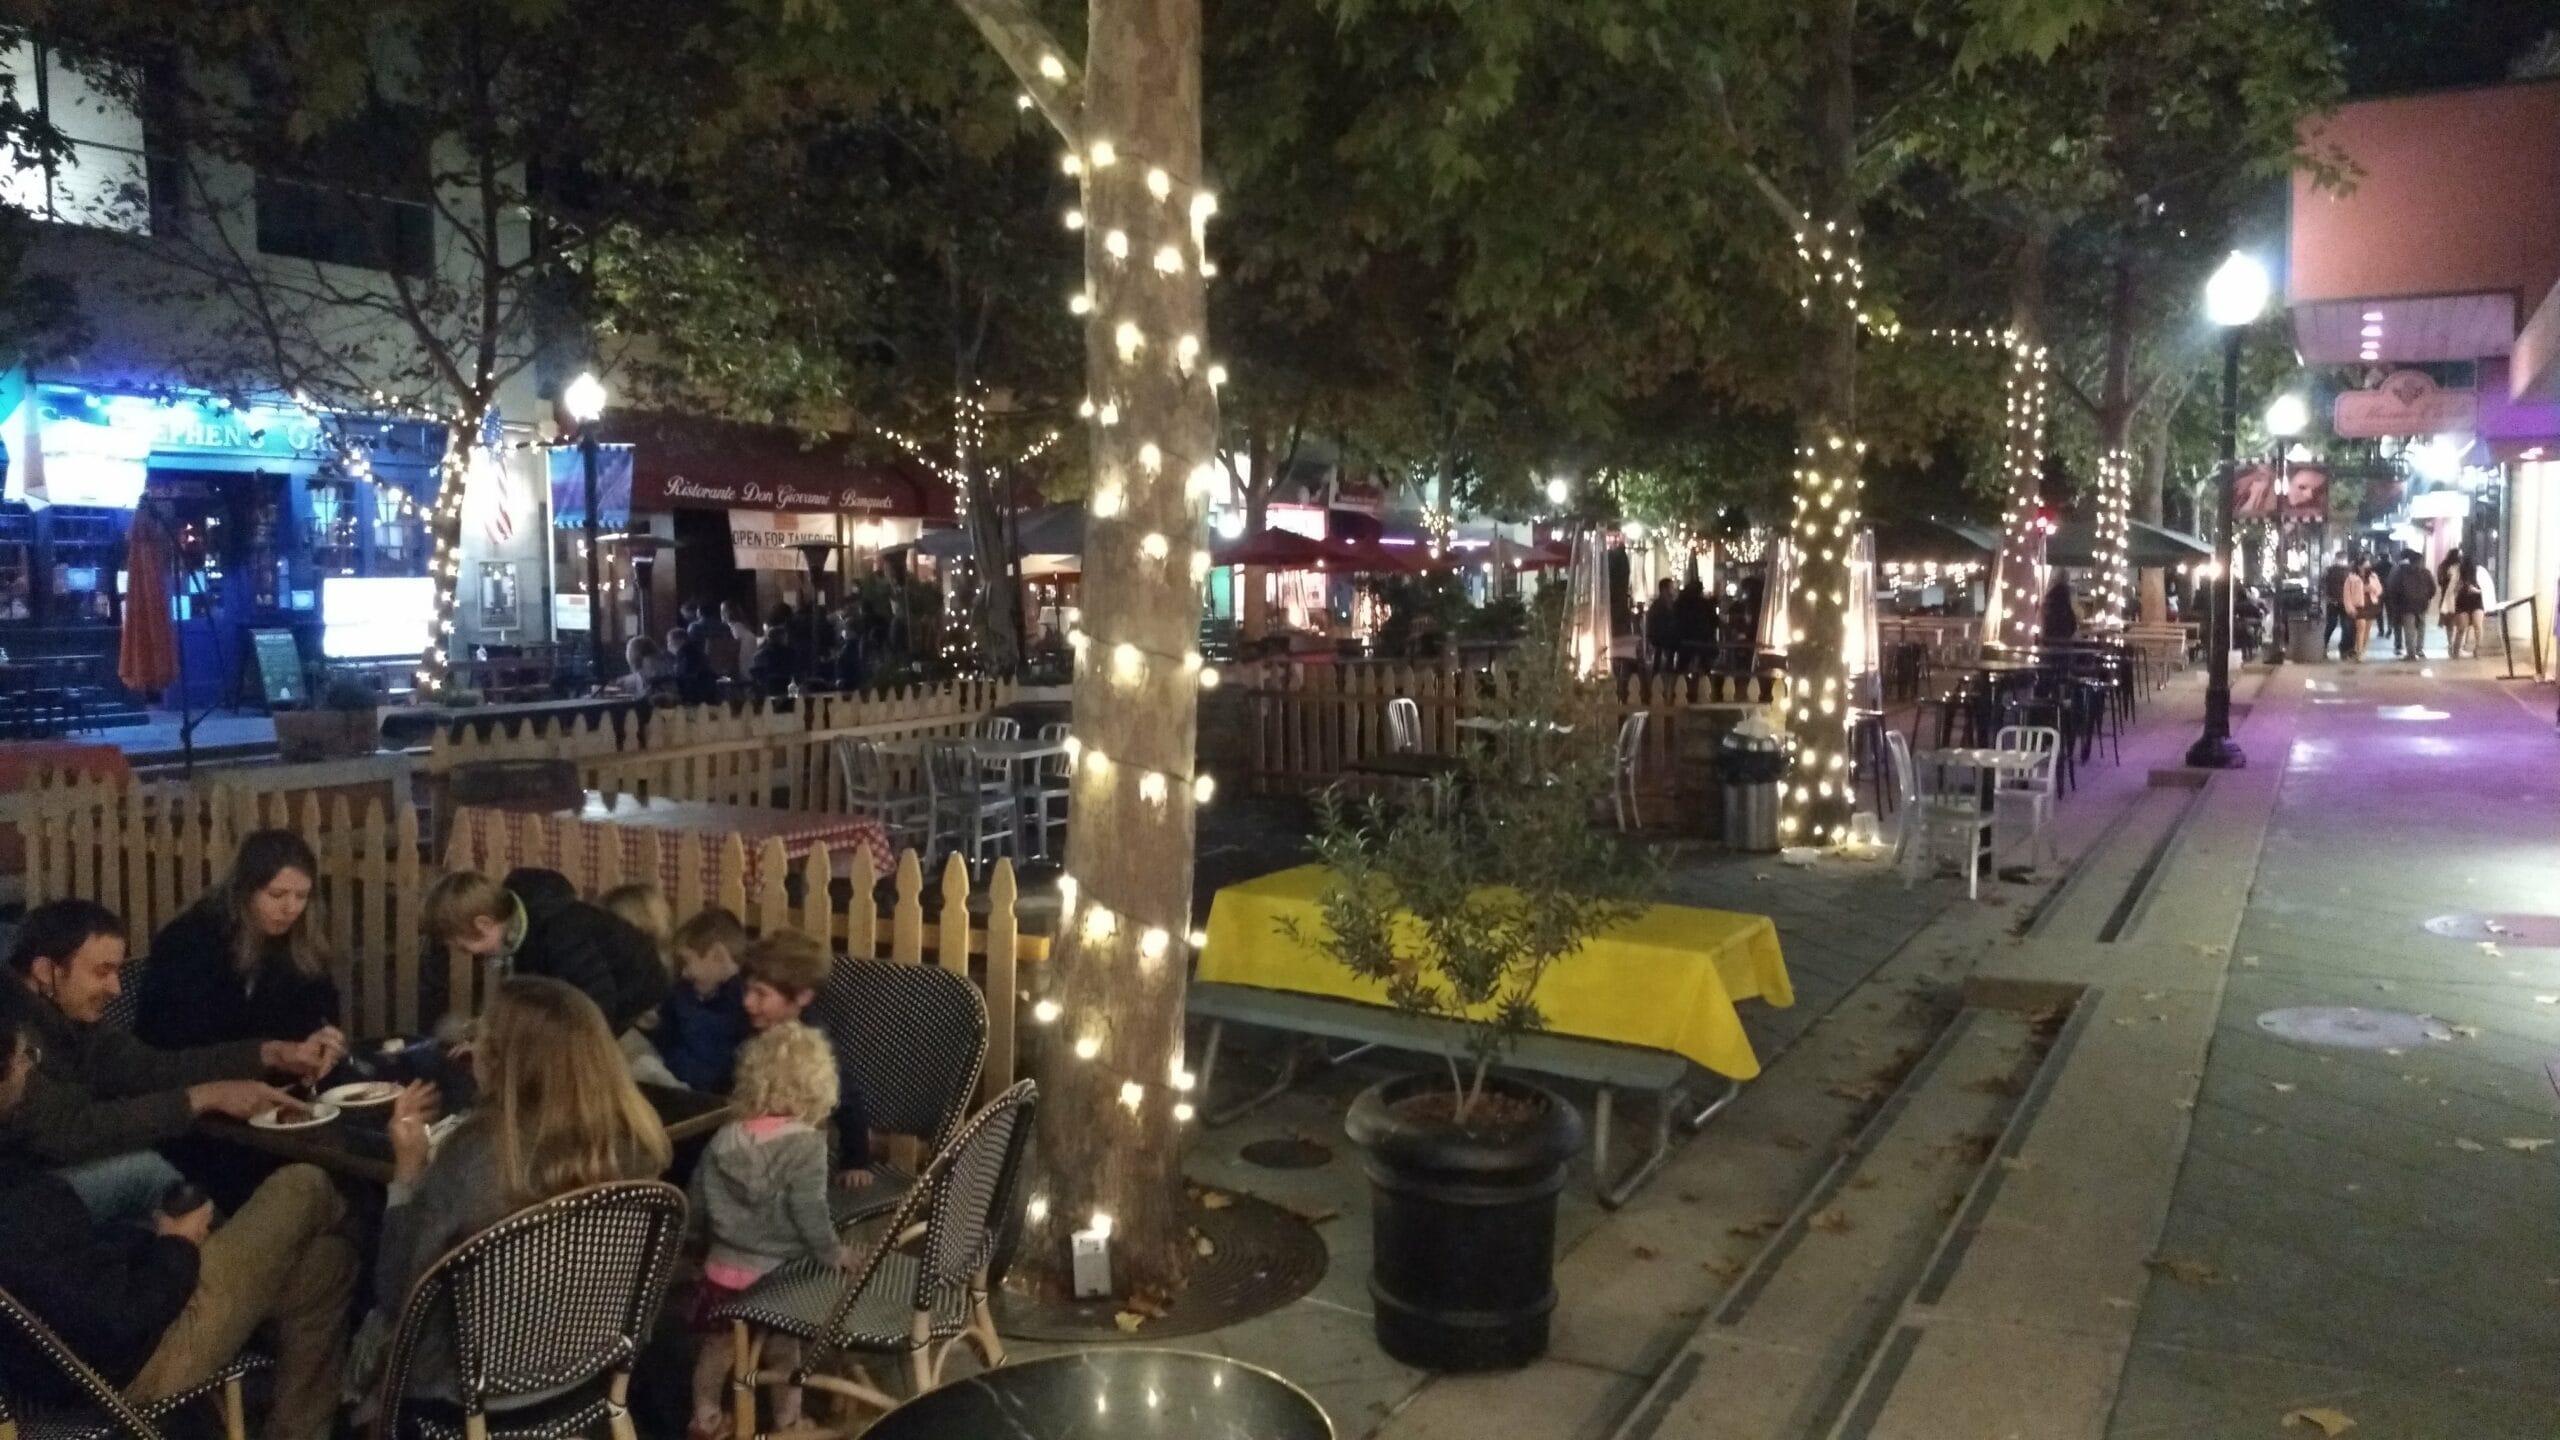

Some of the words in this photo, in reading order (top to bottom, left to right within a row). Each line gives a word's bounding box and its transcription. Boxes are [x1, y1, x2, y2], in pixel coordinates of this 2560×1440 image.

[663, 475, 736, 500] Ristorante
[741, 482, 774, 503] Don
[776, 485, 831, 510] Giovanni
[839, 488, 893, 514] Banquets
[731, 530, 762, 546] OPEN
[764, 532, 785, 547] FOR
